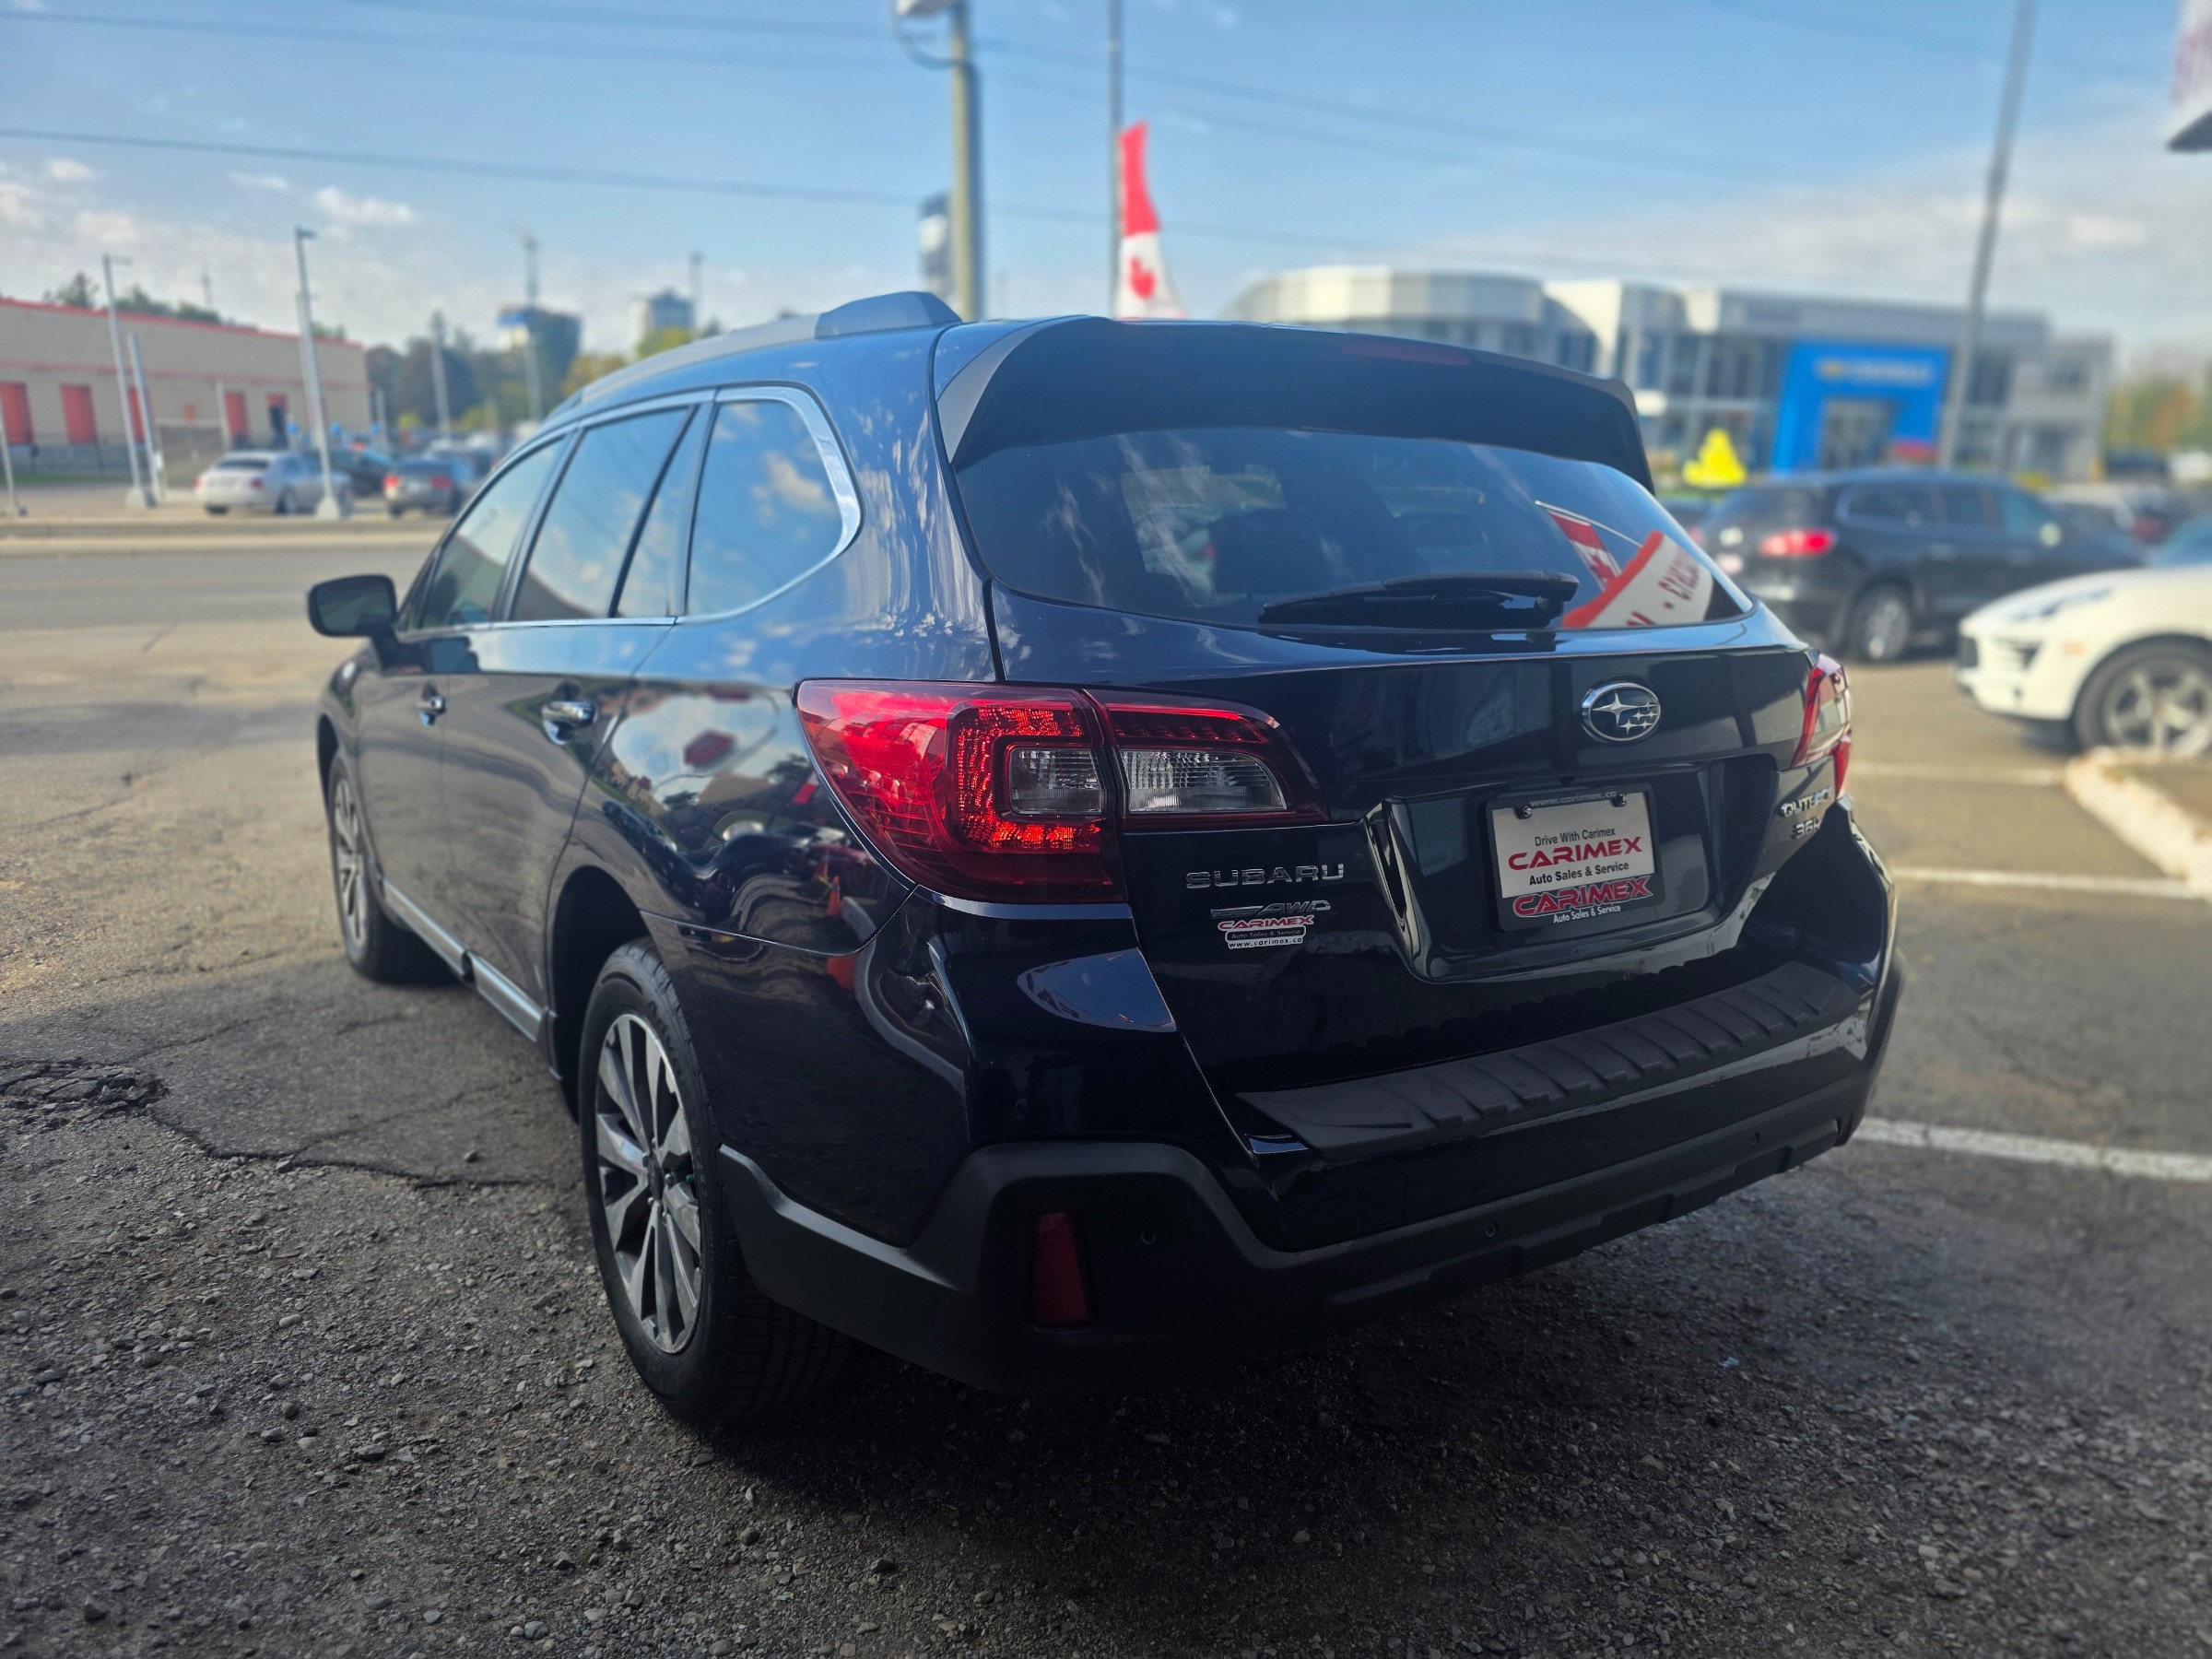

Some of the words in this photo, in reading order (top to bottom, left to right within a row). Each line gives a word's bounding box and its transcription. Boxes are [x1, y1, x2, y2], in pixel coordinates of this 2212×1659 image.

[1535, 834, 1558, 847] Drive
[1559, 831, 1581, 843] With
[1582, 828, 1617, 841] Carimex
[1508, 836, 1643, 871] CARIMEX
[1185, 864, 1345, 889] SUBARU
[1529, 874, 1553, 886] Auto
[1555, 868, 1583, 882] Sales
[1585, 866, 1593, 877] &
[1594, 862, 1630, 876] Service
[1513, 877, 1652, 916] CARIMEX
[1256, 900, 1331, 915] AWD
[1553, 912, 1571, 924] Auto
[1571, 908, 1590, 921] Sales
[1591, 907, 1596, 917] &
[1597, 904, 1621, 916] Service
[1218, 915, 1314, 930] CARIMEX
[1229, 936, 1302, 948] www.carimex.ca
